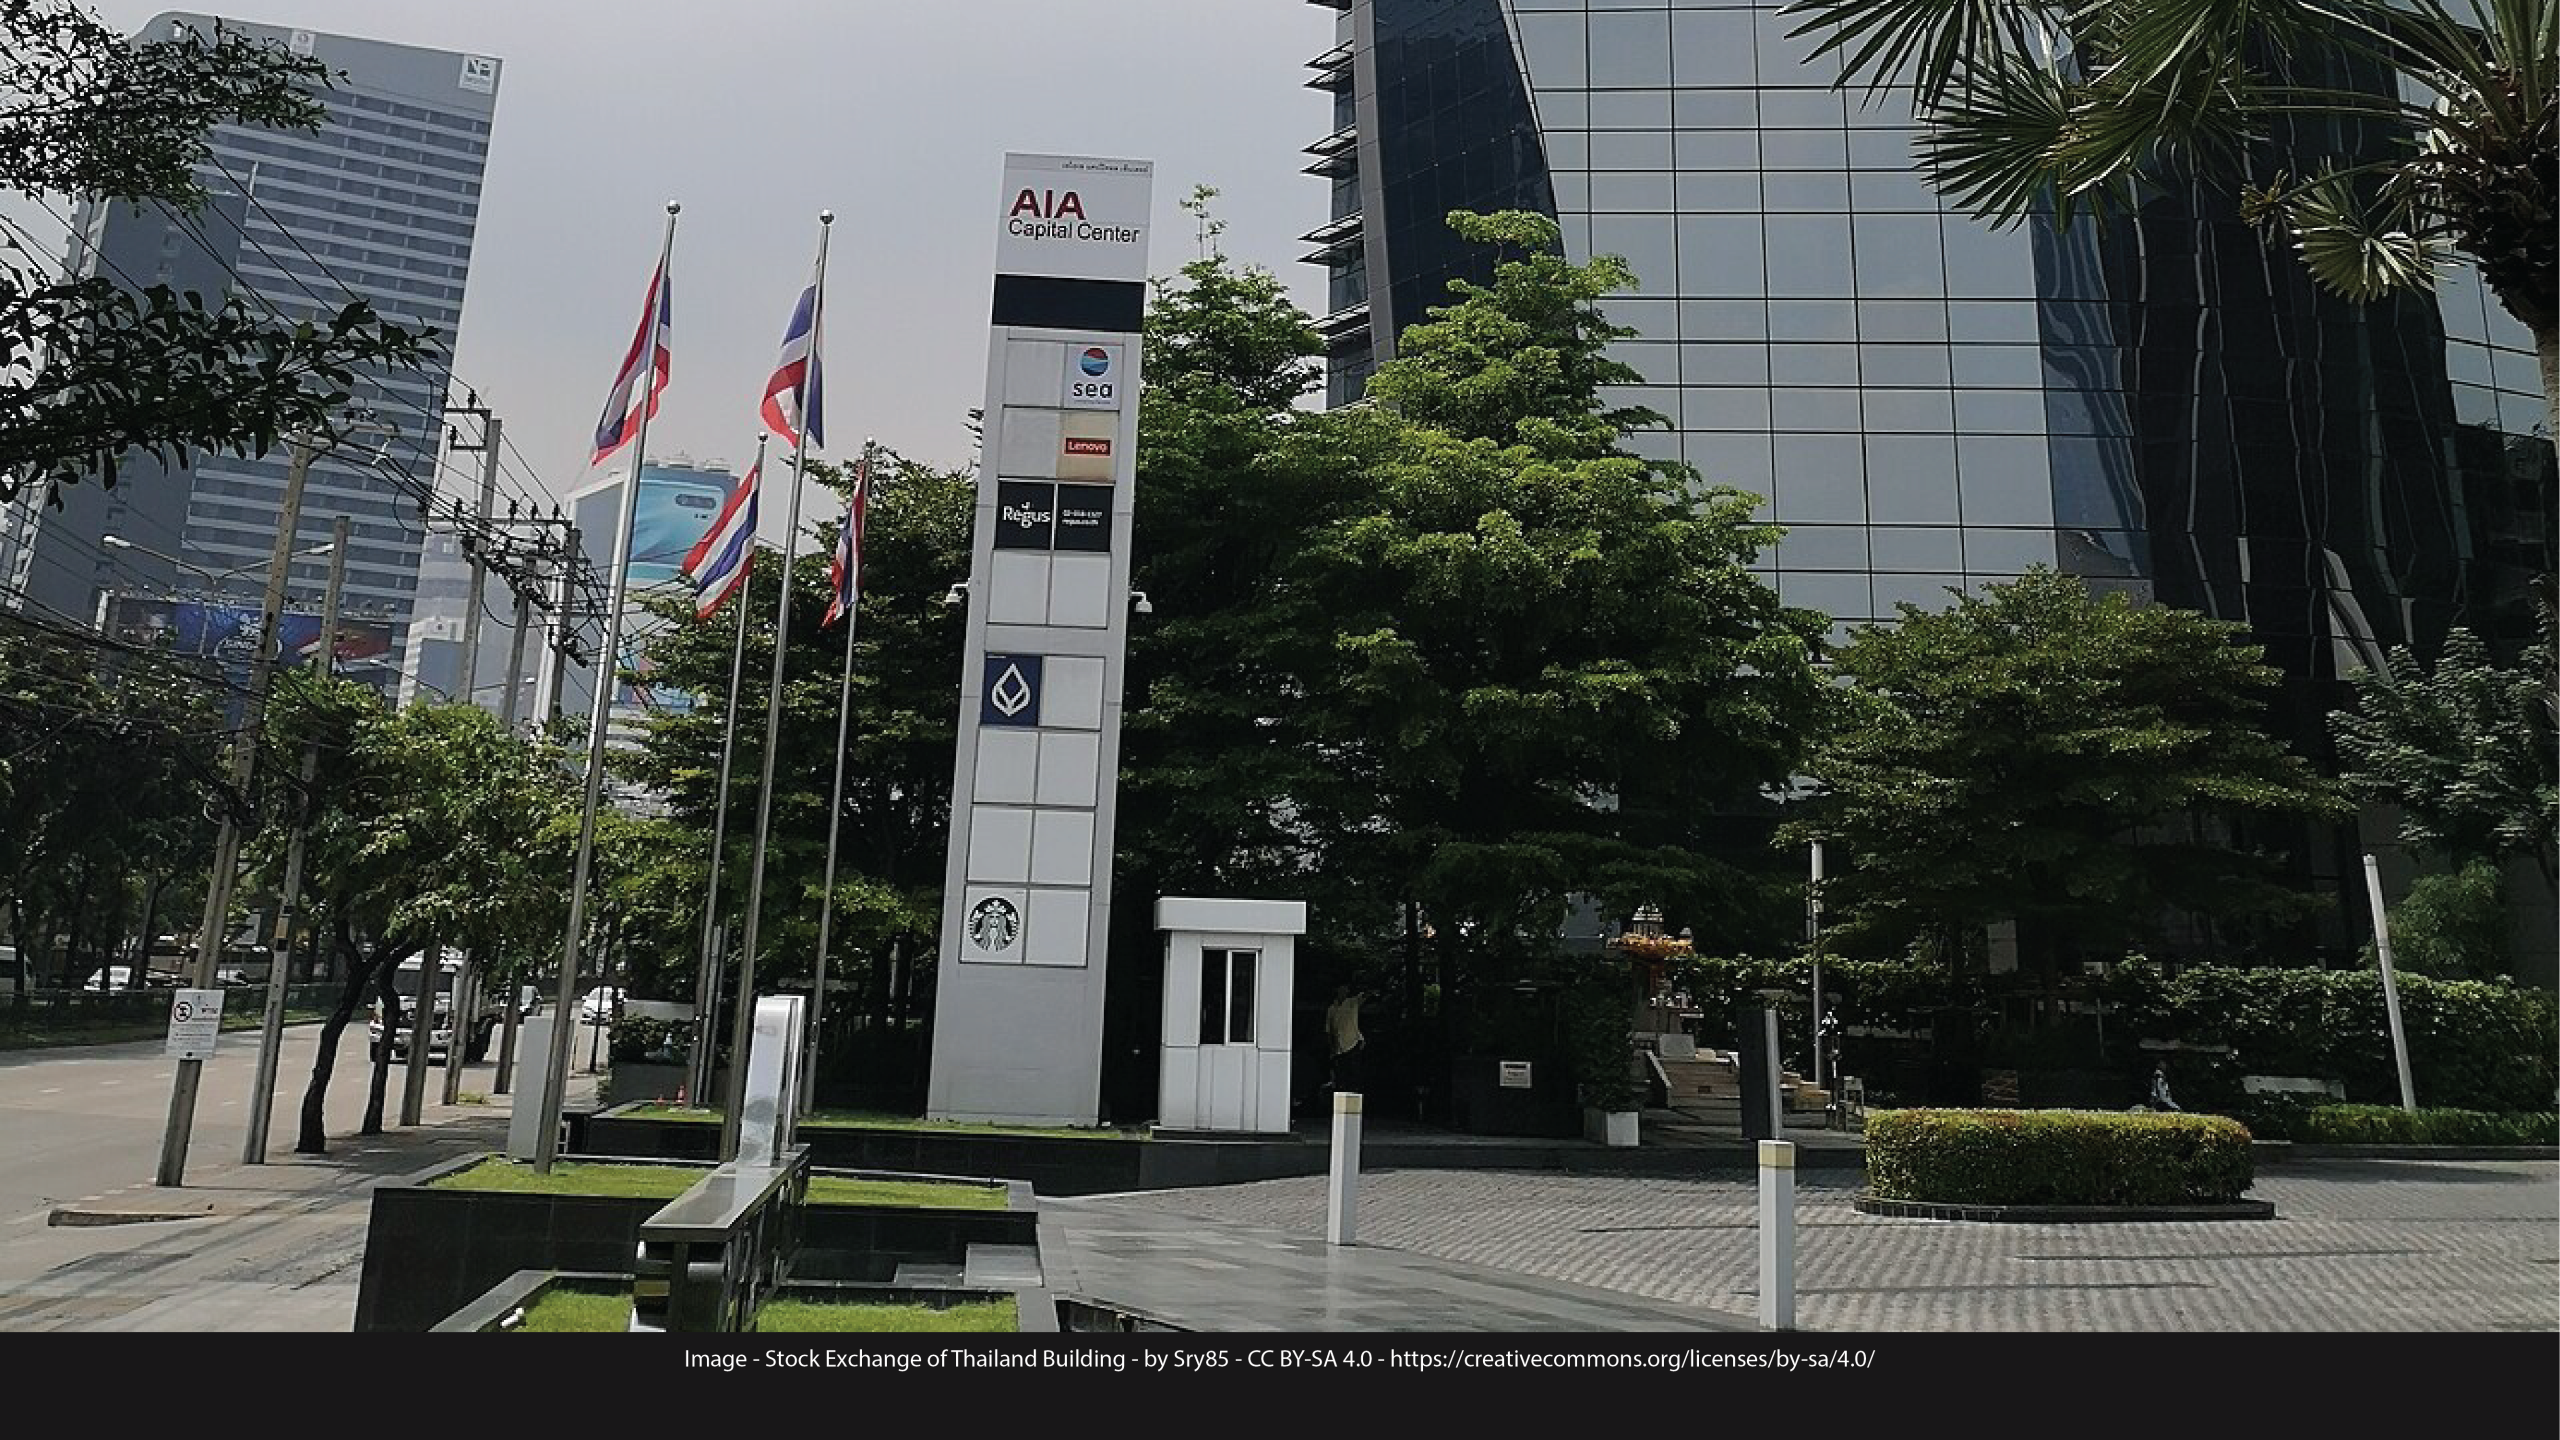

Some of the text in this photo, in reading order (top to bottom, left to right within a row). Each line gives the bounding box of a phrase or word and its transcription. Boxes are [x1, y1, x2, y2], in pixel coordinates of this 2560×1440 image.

[1009, 188, 1087, 220] AIA
[1009, 219, 1141, 243] Capital Center
[1073, 382, 1113, 399] sea
[1068, 441, 1107, 453] Lenovo
[1003, 502, 1051, 529] Regus
